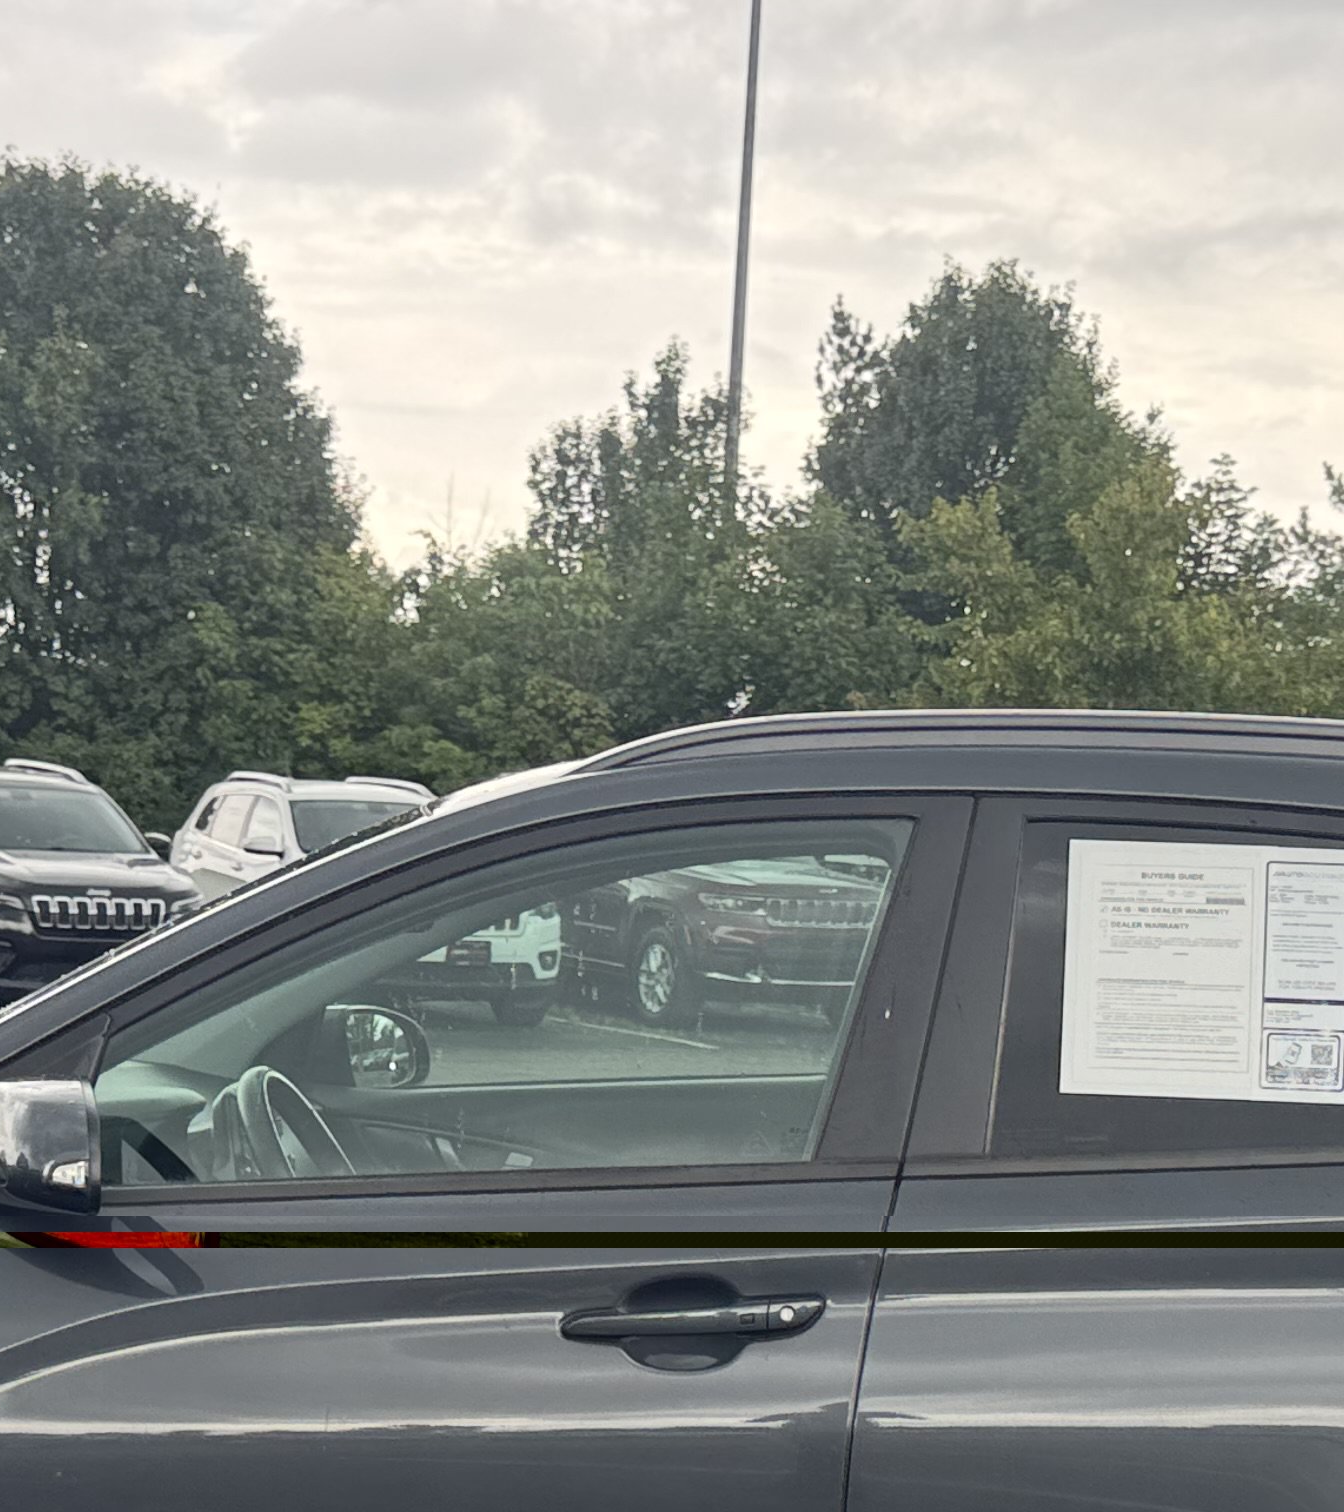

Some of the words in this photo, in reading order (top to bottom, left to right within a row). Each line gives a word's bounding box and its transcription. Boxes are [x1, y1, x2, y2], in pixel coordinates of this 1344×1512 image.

[1178, 873, 1205, 881] GUIDE
[1151, 906, 1184, 915] DEALER
[1185, 907, 1230, 916] WARRANTY
[1110, 921, 1143, 929] DEALER
[1144, 922, 1190, 930] WARRANTY
